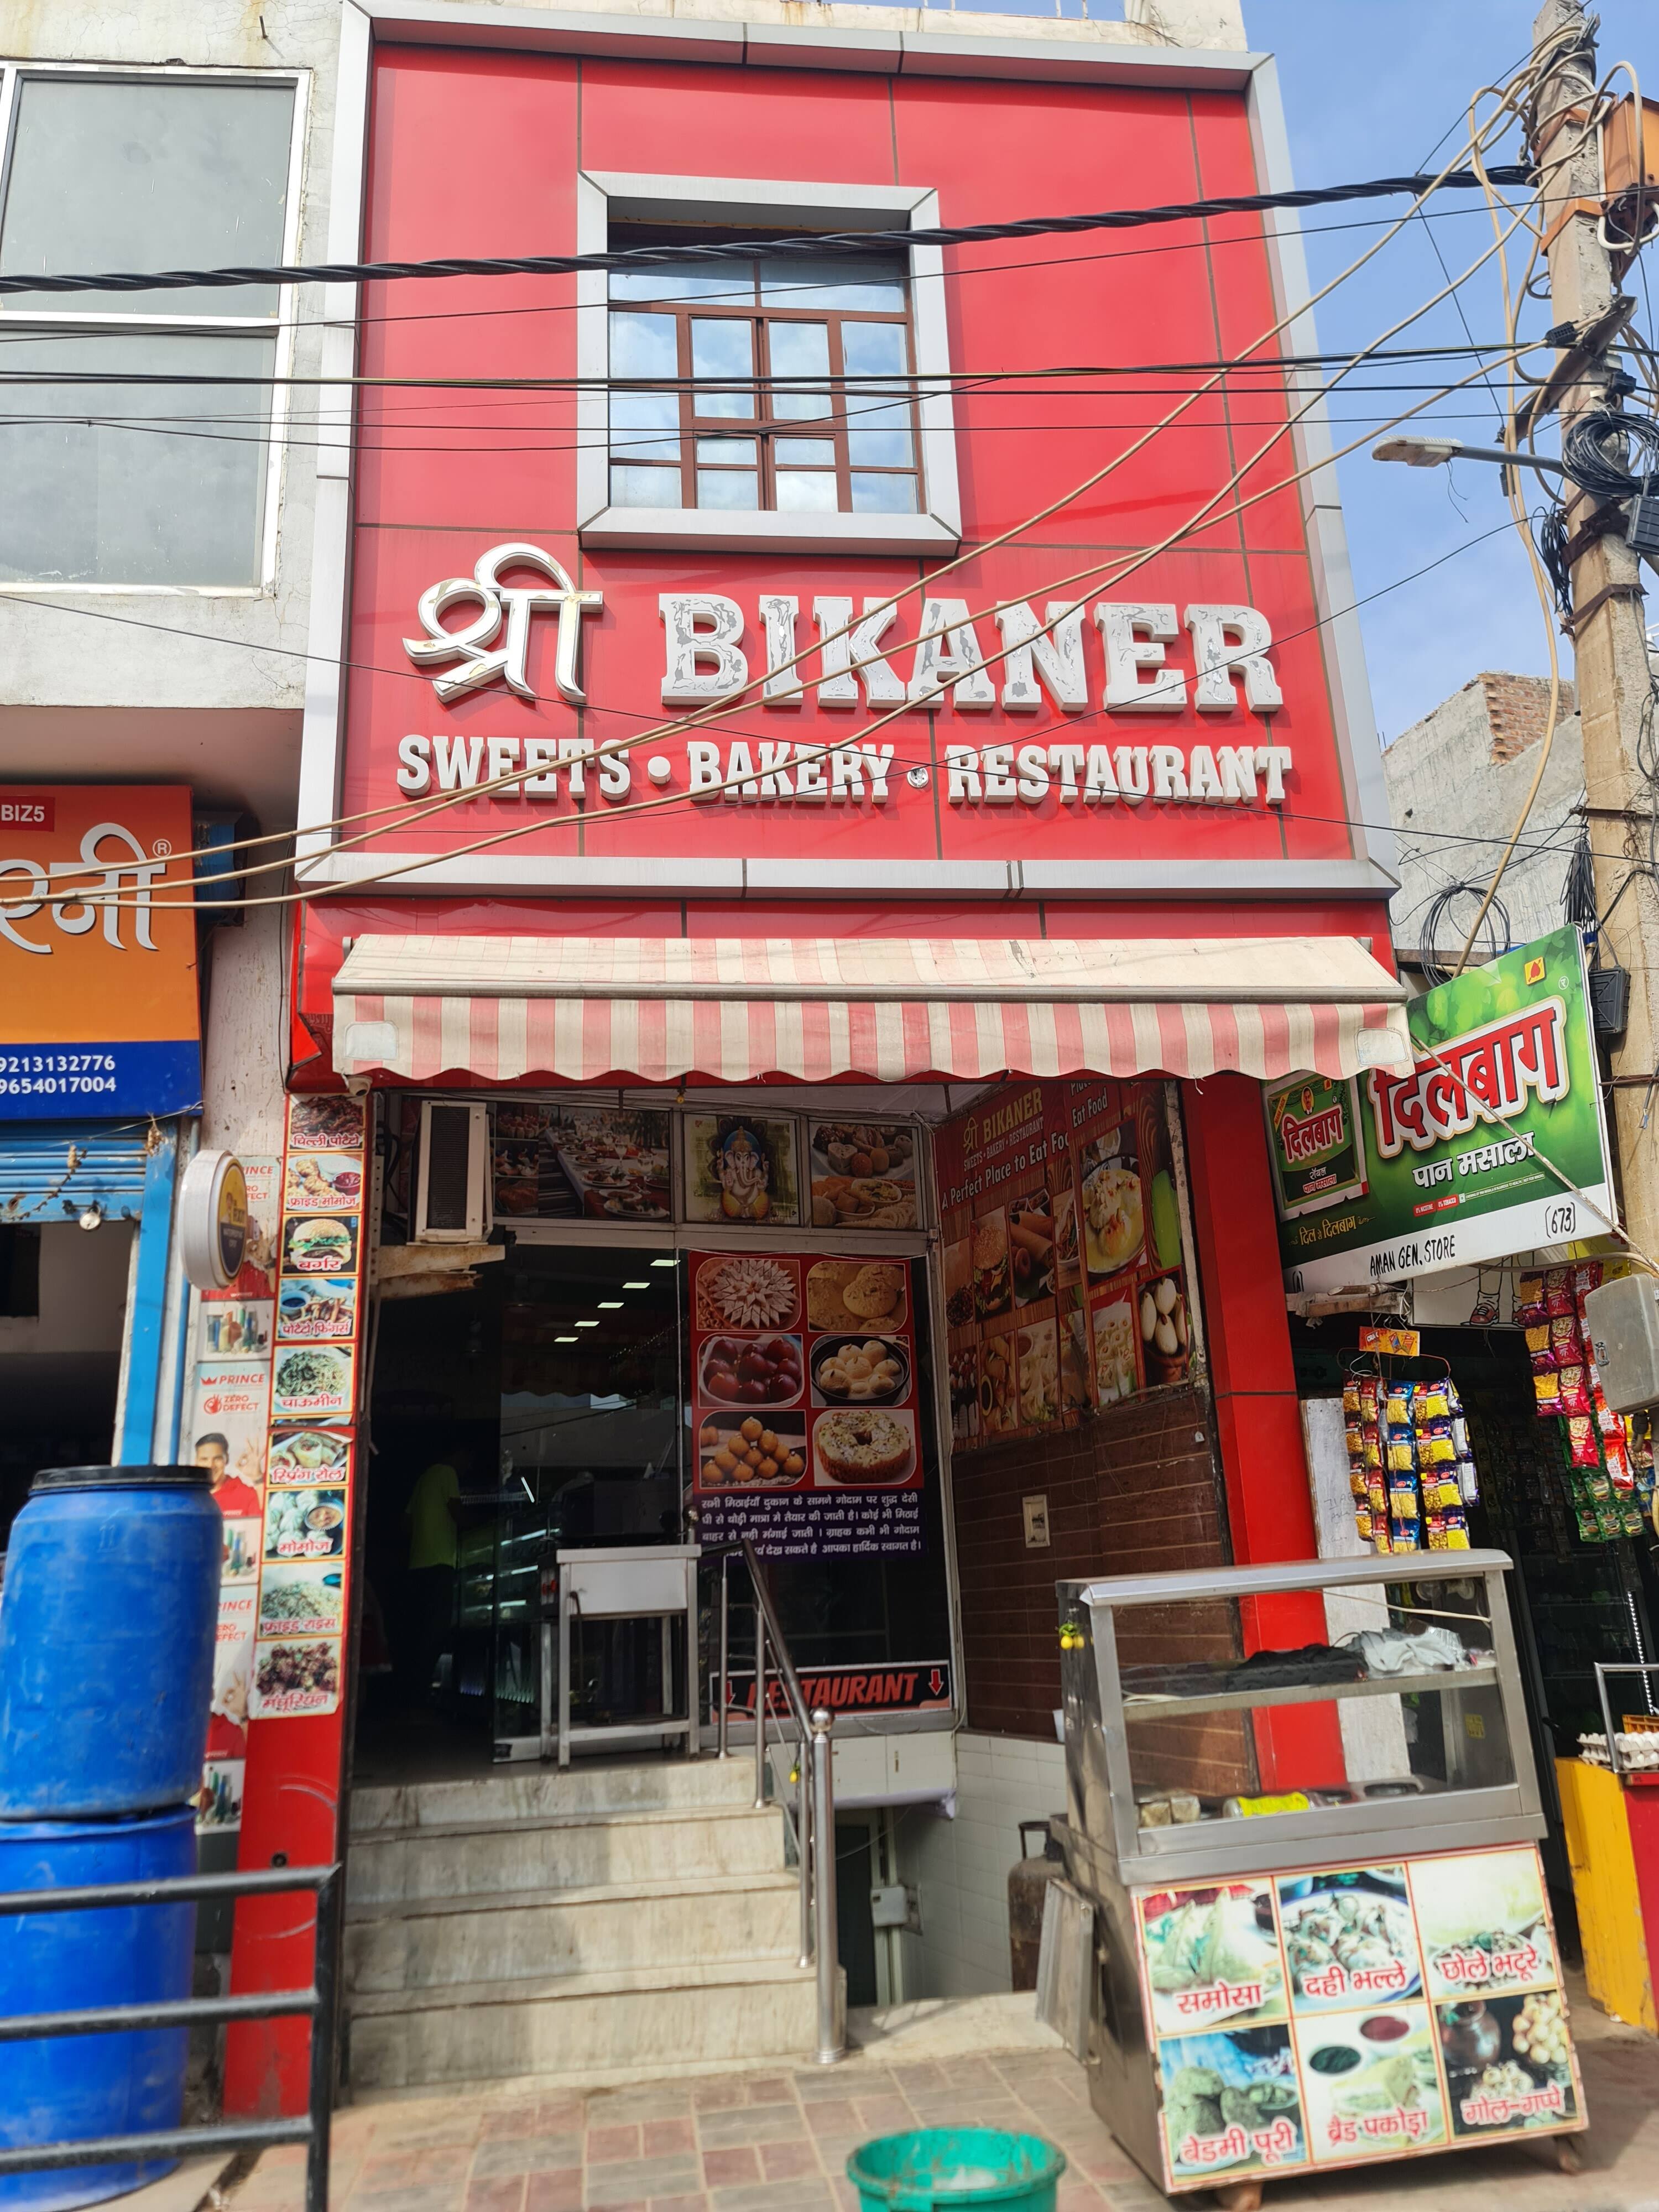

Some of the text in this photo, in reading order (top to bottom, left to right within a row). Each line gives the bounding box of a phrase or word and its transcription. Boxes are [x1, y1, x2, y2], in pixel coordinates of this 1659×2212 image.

[402, 542, 1284, 712] श्री BIKANER
[397, 734, 1291, 805] SWEETS BAKERY RESTAURANT
[1, 805, 45, 822] BIZ5
[0, 1055, 116, 1073] 9213132776
[0, 1076, 117, 1095] 9654017004
[1072, 1087, 1108, 1129] Eat Food
[963, 1087, 1043, 1155] श्री BIKANER
[293, 1133, 326, 1145] चिल्ली
[1284, 1107, 1342, 1160] दिलबाग
[964, 1117, 1044, 1172] SWEETS BAKERY RESTAURANT
[1412, 1131, 1536, 1188] पान मसाला
[244, 1166, 274, 1175] INCE
[942, 1191, 949, 1211] A
[951, 1175, 983, 1206] Perfect
[985, 1162, 1011, 1188] Place
[1014, 1154, 1026, 1173] to
[1029, 1140, 1048, 1165] Eat
[1310, 1166, 1327, 1180] रॉयल
[1303, 1173, 1337, 1193] पान मसाला
[290, 1193, 356, 1207] फ्राइड मोमोज
[1300, 1226, 1317, 1245] दिल
[1322, 1215, 1357, 1238] दिलबाग
[1545, 1202, 1576, 1239] (673)
[299, 1256, 340, 1270] बर्गर
[1370, 1234, 1455, 1277] AMAN GEN. STORE
[219, 1374, 265, 1384] PRINCE
[222, 1402, 259, 1411] DEFECT
[282, 1394, 342, 1407] चाऊमीन
[315, 1468, 342, 1479] रोल
[701, 1496, 721, 1509] सभी
[763, 1498, 789, 1511] दुकान
[793, 1495, 803, 1505] के
[807, 1494, 831, 1505] सामने
[836, 1494, 862, 1504] गोदाम
[881, 1495, 898, 1507] शुद्ध
[901, 1492, 917, 1503] देसी
[702, 1513, 712, 1525] घी
[715, 1513, 724, 1525] से
[749, 1514, 770, 1522] मात्रा
[784, 1510, 806, 1522] तैयार
[808, 1510, 820, 1521] की
[823, 1509, 844, 1521] जाती
[861, 1509, 879, 1521] कोई
[882, 1508, 892, 1519] भी
[895, 1507, 919, 1520] मिठाई
[702, 1532, 724, 1542] बाहर
[728, 1529, 737, 1540] से
[792, 1526, 813, 1537] जाती
[826, 1528, 852, 1538] ग्राहक
[856, 1524, 875, 1535] कभी
[879, 1524, 889, 1535] भी
[894, 1524, 920, 1535] गोदाम
[279, 1539, 331, 1553] मोमोज
[766, 1545, 782, 1556] देख
[784, 1543, 808, 1555] सकते
[822, 1543, 851, 1553] आपका
[853, 1540, 879, 1553] हार्दिक
[881, 1542, 909, 1551] स्वागत
[216, 1624, 236, 1632] ERO
[304, 1618, 336, 1629] राइस
[747, 1673, 919, 1710] ETAURANT
[1441, 1943, 1538, 1981] छोले भटूरे
[1304, 1960, 1408, 1997] दही भल्ले
[1176, 1982, 1262, 2014] समोसा
[1462, 2084, 1562, 2122] गोल-गप्पे
[1363, 2107, 1430, 2137] पकोड़ा
[1182, 2120, 1294, 2162] बेडमी पूरी
